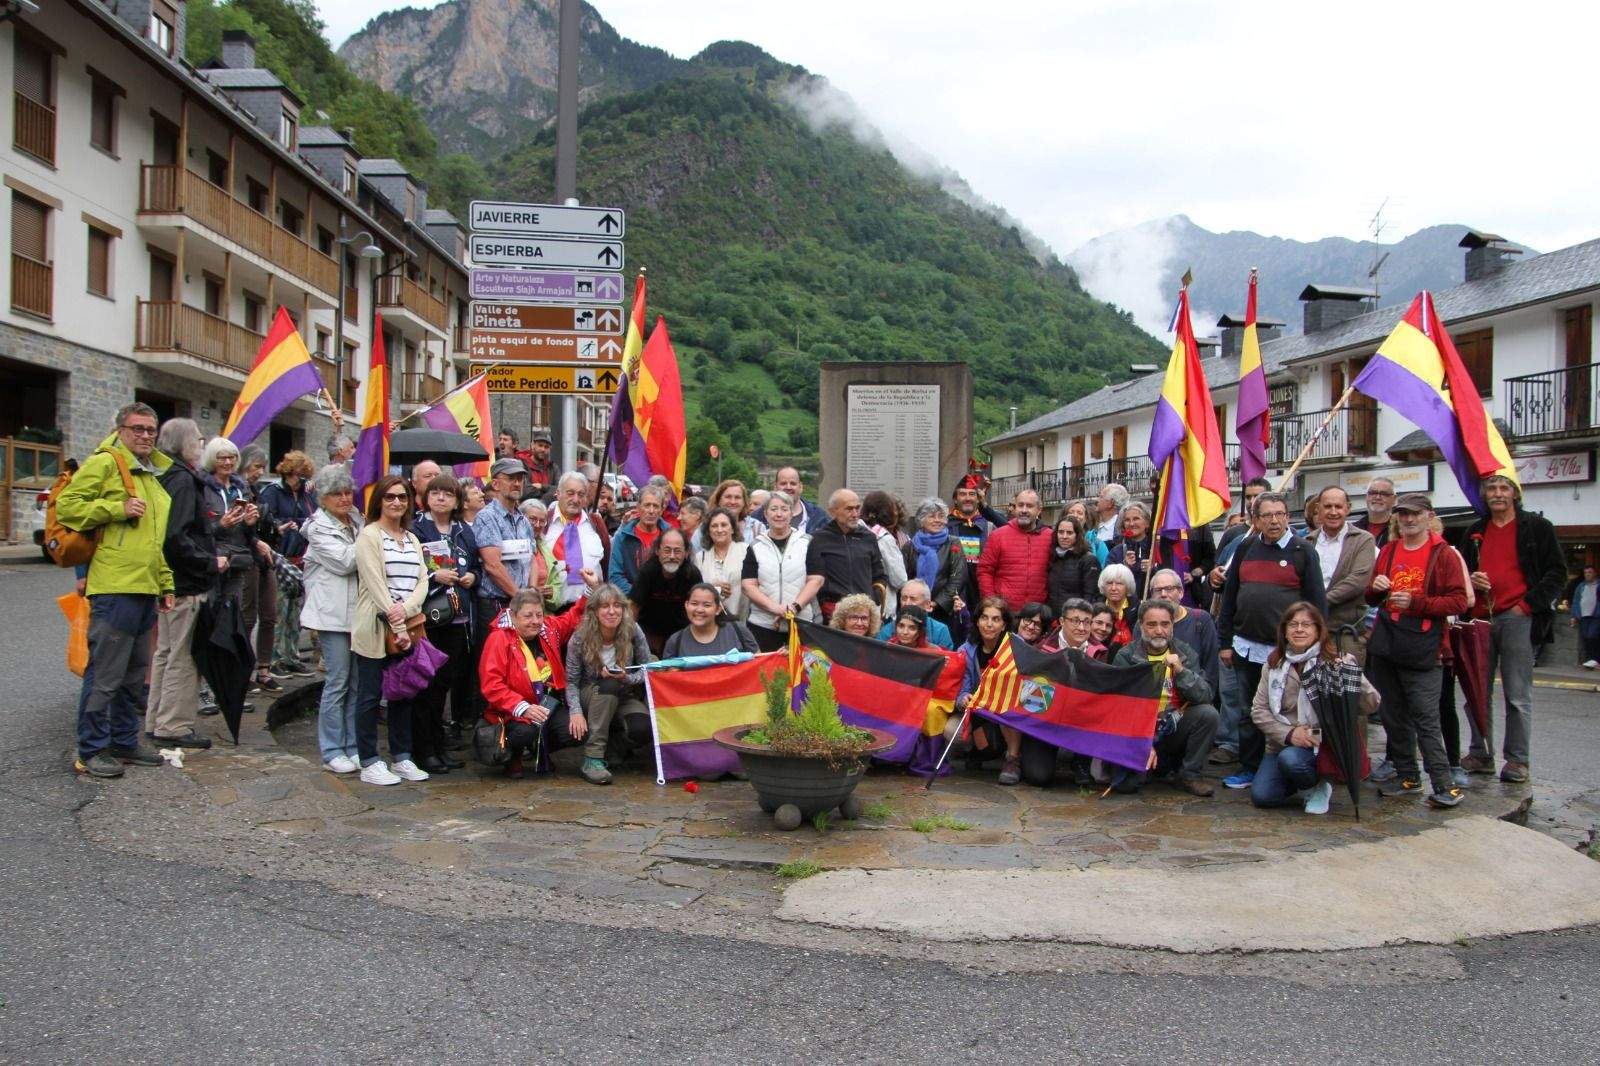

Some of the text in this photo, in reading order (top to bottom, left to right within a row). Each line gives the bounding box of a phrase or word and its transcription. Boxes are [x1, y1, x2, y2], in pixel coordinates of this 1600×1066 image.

[476, 211, 540, 225] JAVIERRE
[475, 244, 543, 257] ESPIERBA
[475, 273, 545, 285] Arte y Naturaleza
[475, 283, 514, 294] Escultura
[538, 287, 573, 297] Armajani
[475, 305, 518, 315] Valle de
[474, 316, 522, 328] Pineta
[472, 336, 574, 346] pista esquí de fondo
[472, 347, 506, 356] 14 Km
[519, 378, 568, 389] Perdido
[1267, 386, 1293, 404] CIONES
